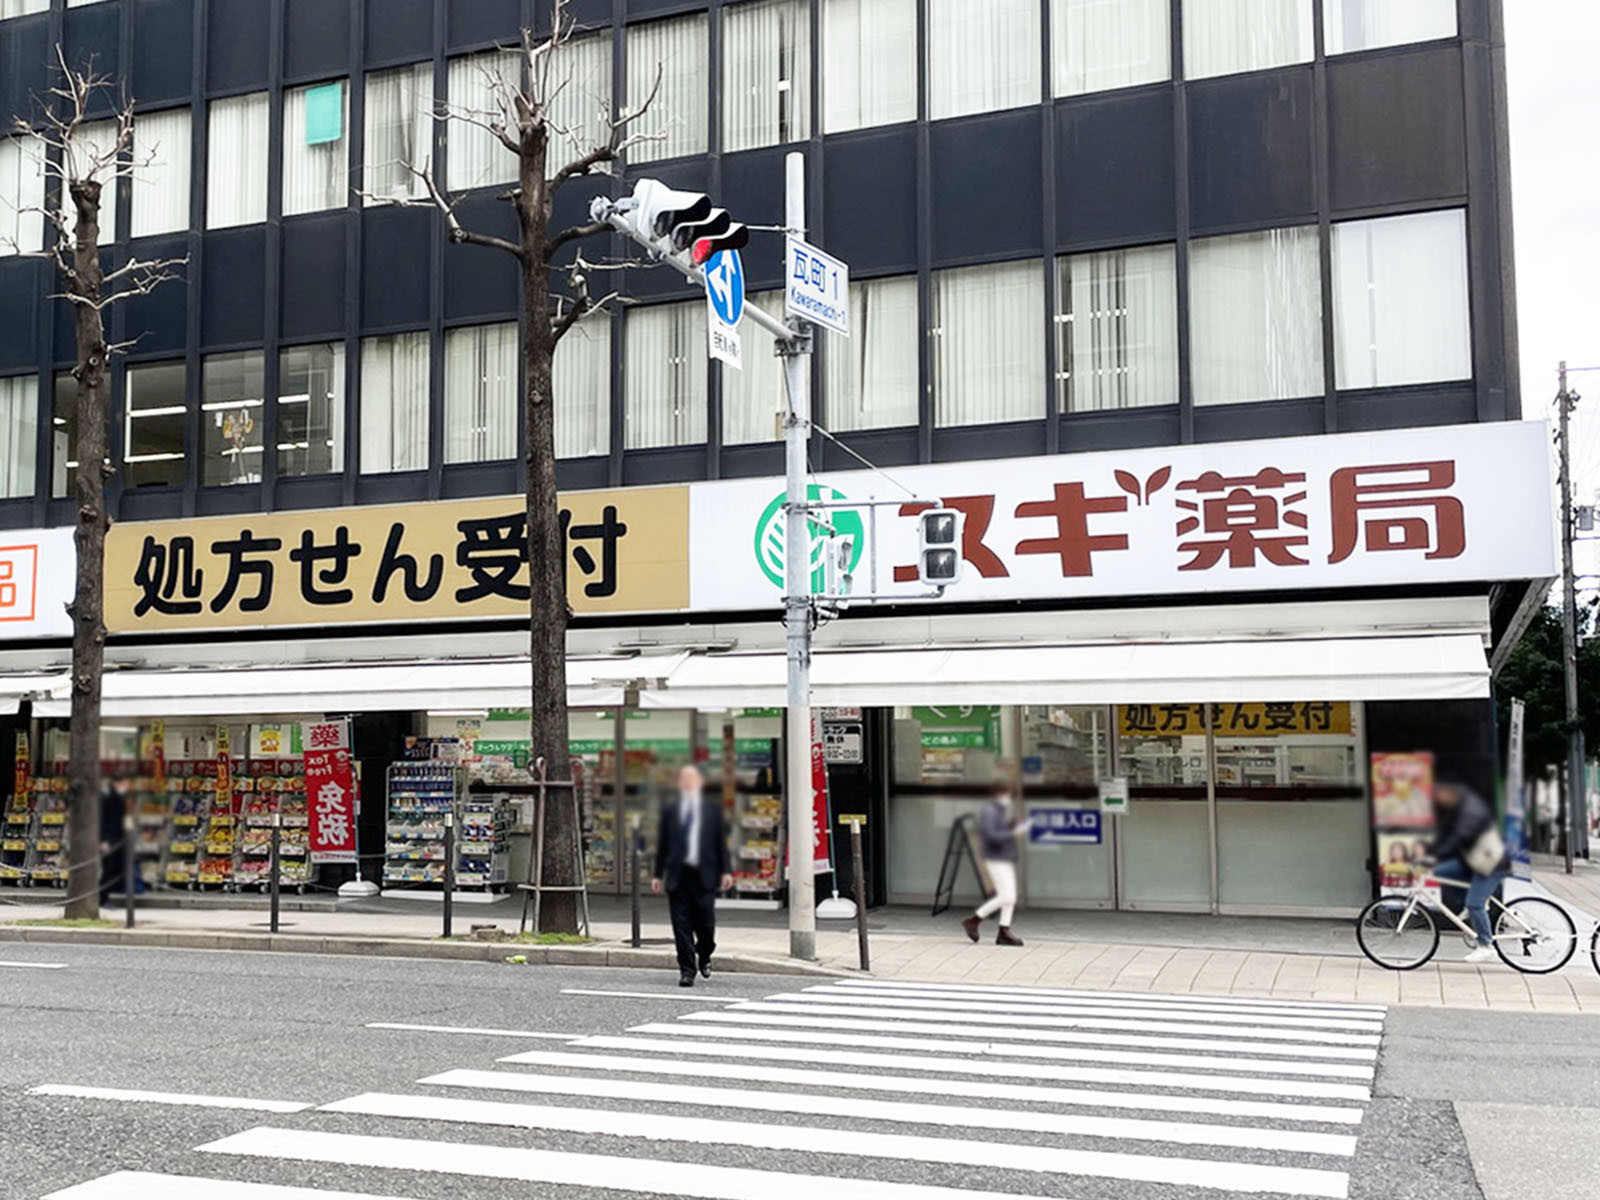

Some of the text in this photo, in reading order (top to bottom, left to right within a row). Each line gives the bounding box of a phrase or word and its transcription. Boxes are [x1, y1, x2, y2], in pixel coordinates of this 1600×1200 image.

[793, 248, 826, 293] 瓦町
[134, 505, 627, 617] 処方せん受付
[1125, 702, 1332, 732] 処方せん受付
